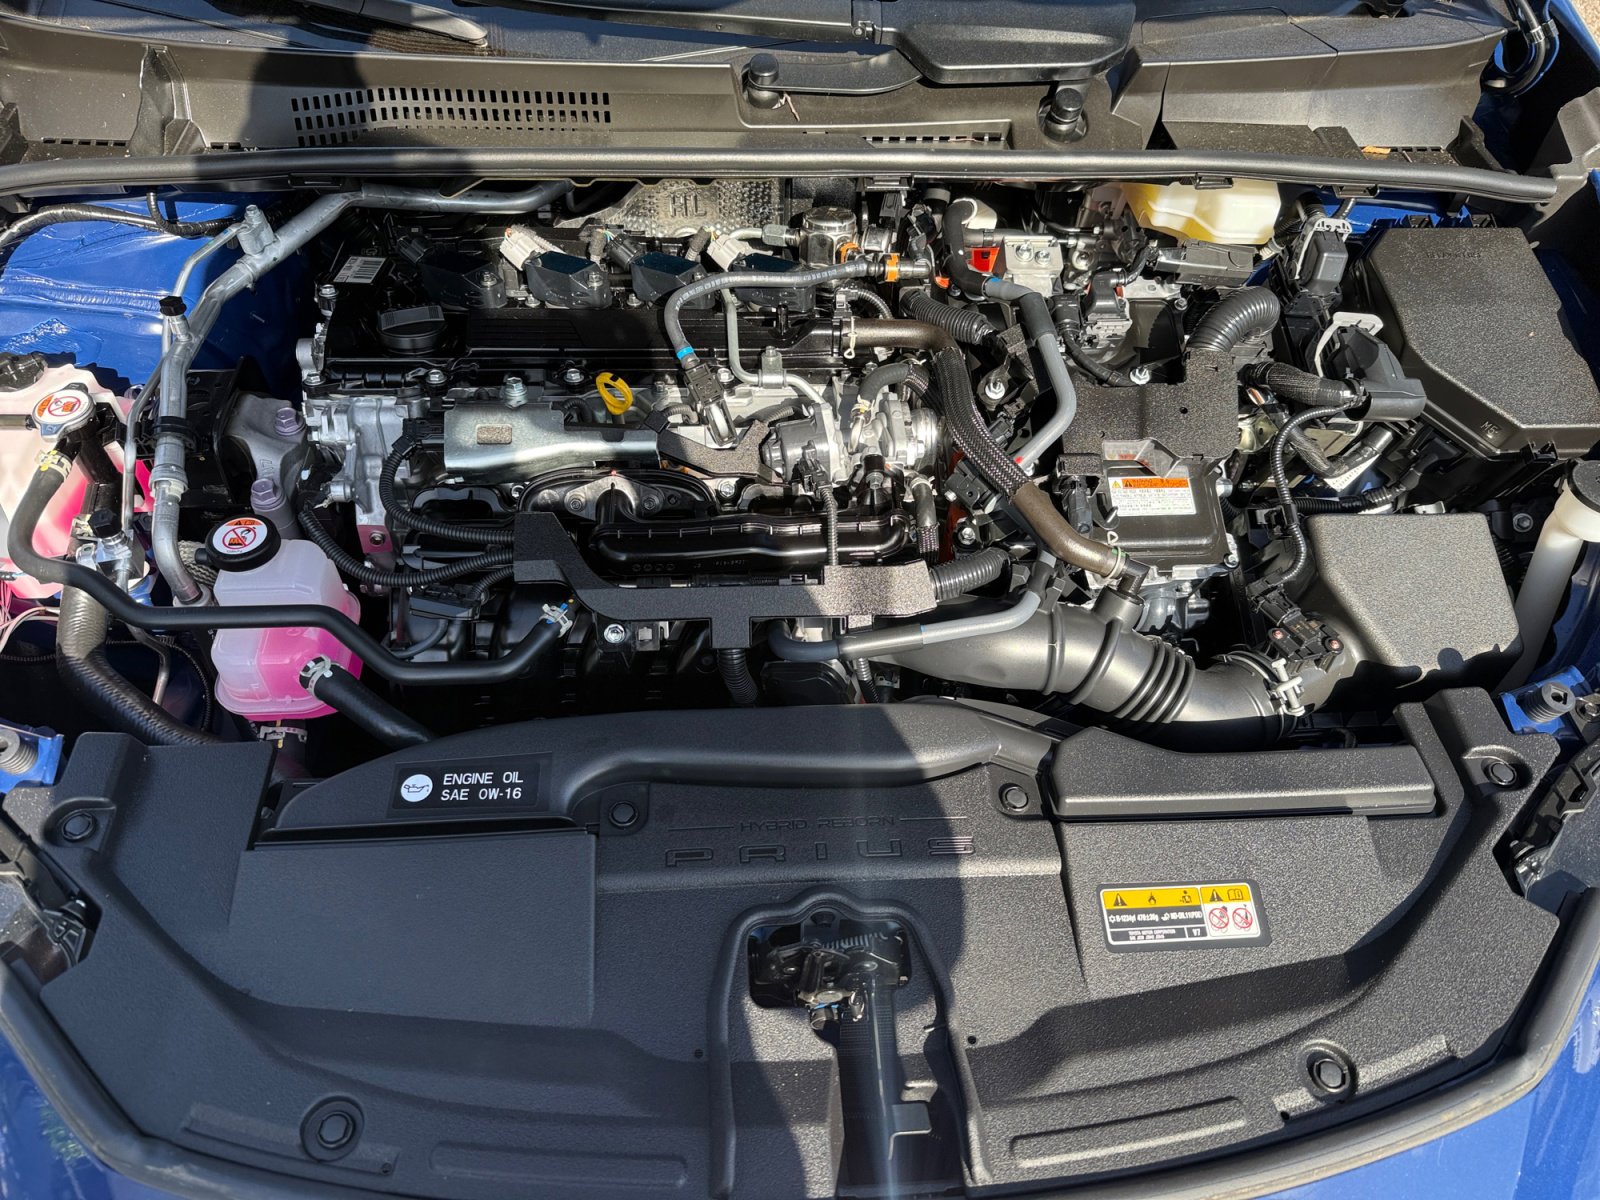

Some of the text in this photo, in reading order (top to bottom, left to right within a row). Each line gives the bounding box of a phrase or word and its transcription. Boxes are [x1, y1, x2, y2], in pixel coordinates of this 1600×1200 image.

[443, 771, 524, 785] ENGINE OIL
[440, 787, 522, 801] SAE 0W-16
[740, 815, 895, 833] HYBRID REBORN
[664, 836, 976, 868] PRIUS
